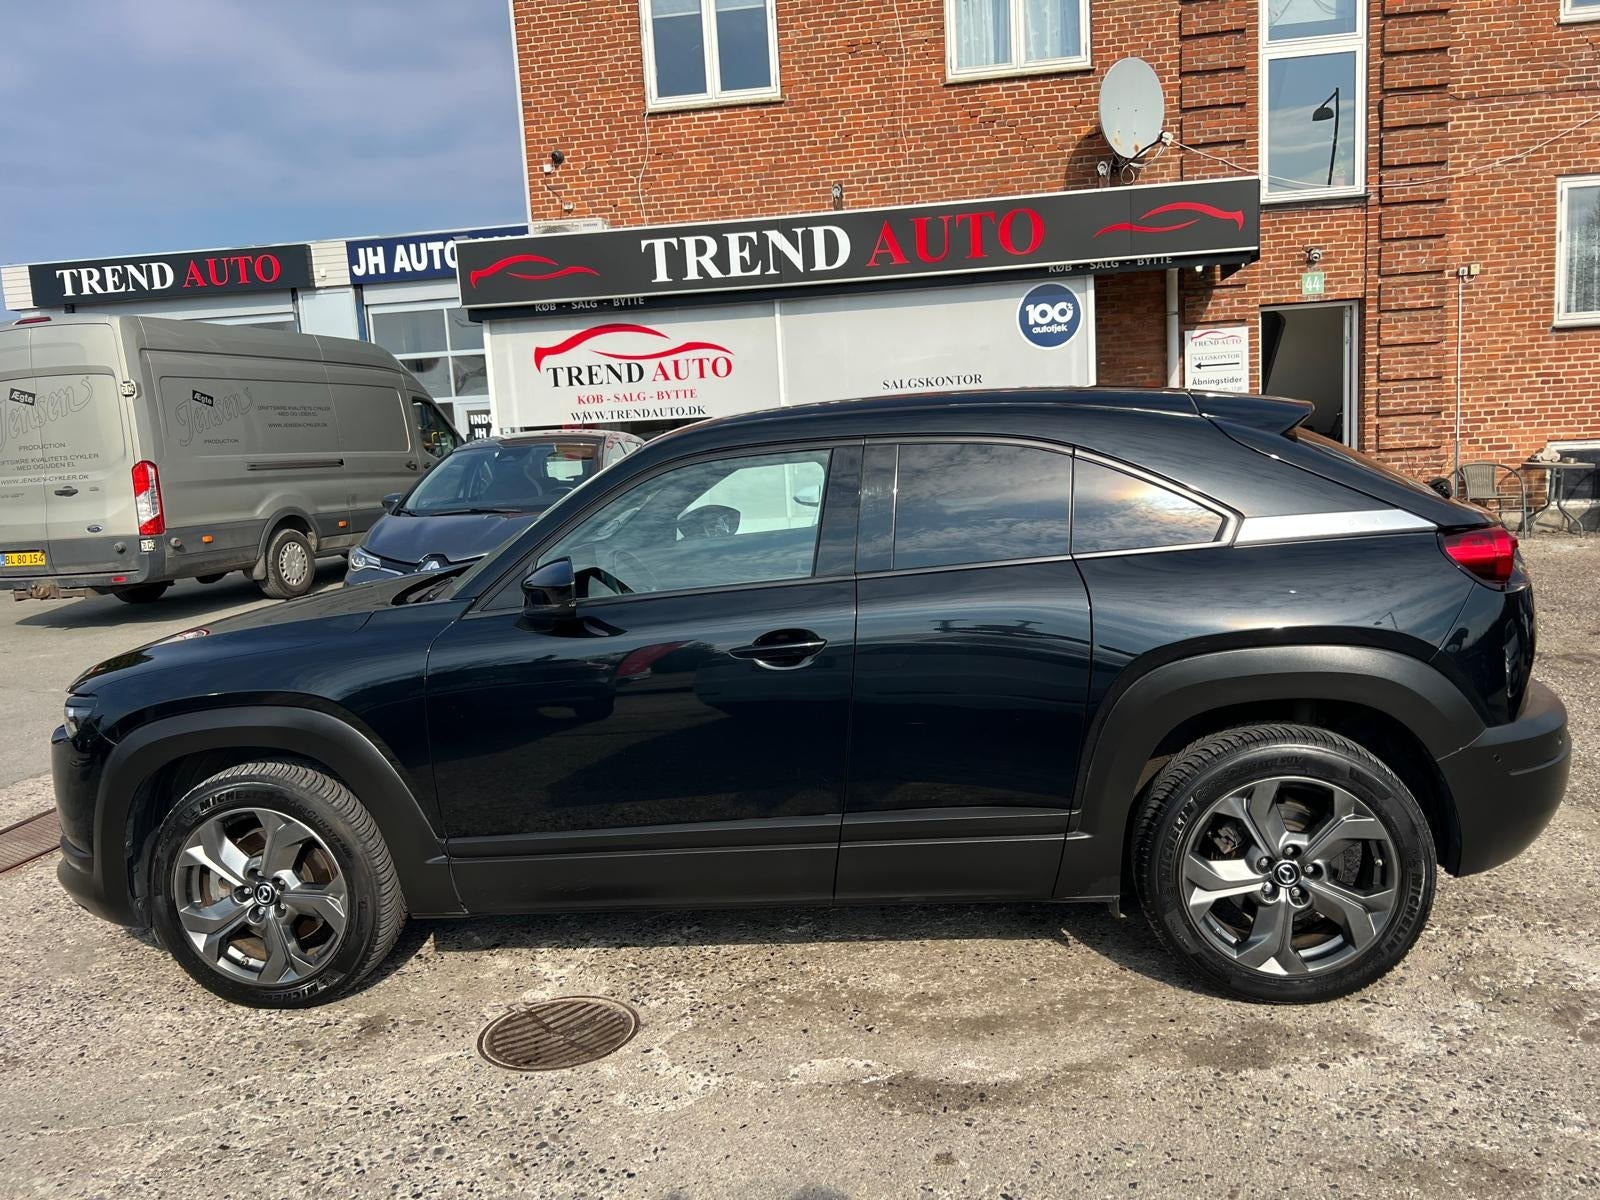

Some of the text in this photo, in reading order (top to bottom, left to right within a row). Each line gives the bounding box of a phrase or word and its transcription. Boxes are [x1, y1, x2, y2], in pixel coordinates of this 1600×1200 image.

[641, 207, 1046, 284] TREND AUTO
[352, 246, 386, 276] JH
[1048, 264, 1073, 273] KØB
[1089, 260, 1119, 270] SALG
[1137, 256, 1173, 266] BYTTE
[56, 254, 281, 297] TREND AUTO
[1305, 276, 1321, 290] 44
[534, 302, 557, 312] KØB
[571, 299, 598, 310] SALG
[612, 296, 645, 307] BYTTE
[1032, 323, 1068, 335] autotjek
[1193, 338, 1242, 347] TREND AUTO
[1193, 353, 1240, 361] SALGSKONTOR
[546, 356, 733, 388] TREND AUTO
[882, 374, 983, 390] SALGSKONTOR
[1192, 376, 1243, 386] Åbningstider
[11, 390, 34, 404] Ægte
[193, 392, 213, 405] Ægte
[577, 394, 604, 405] KØB
[613, 391, 646, 402] SALG
[656, 388, 698, 401] BYTTE
[174, 389, 253, 447] Jensen
[571, 405, 706, 422] WWW.TRENDAUTO.DK
[18, 442, 66, 452] PRODUCTION
[31, 455, 68, 463] KVALITETS
[0, 474, 89, 485] WWW.JENSEN-CYKLER.DK
[5, 553, 44, 565] BL 80 154
[1384, 872, 1424, 954] MICHELIN
